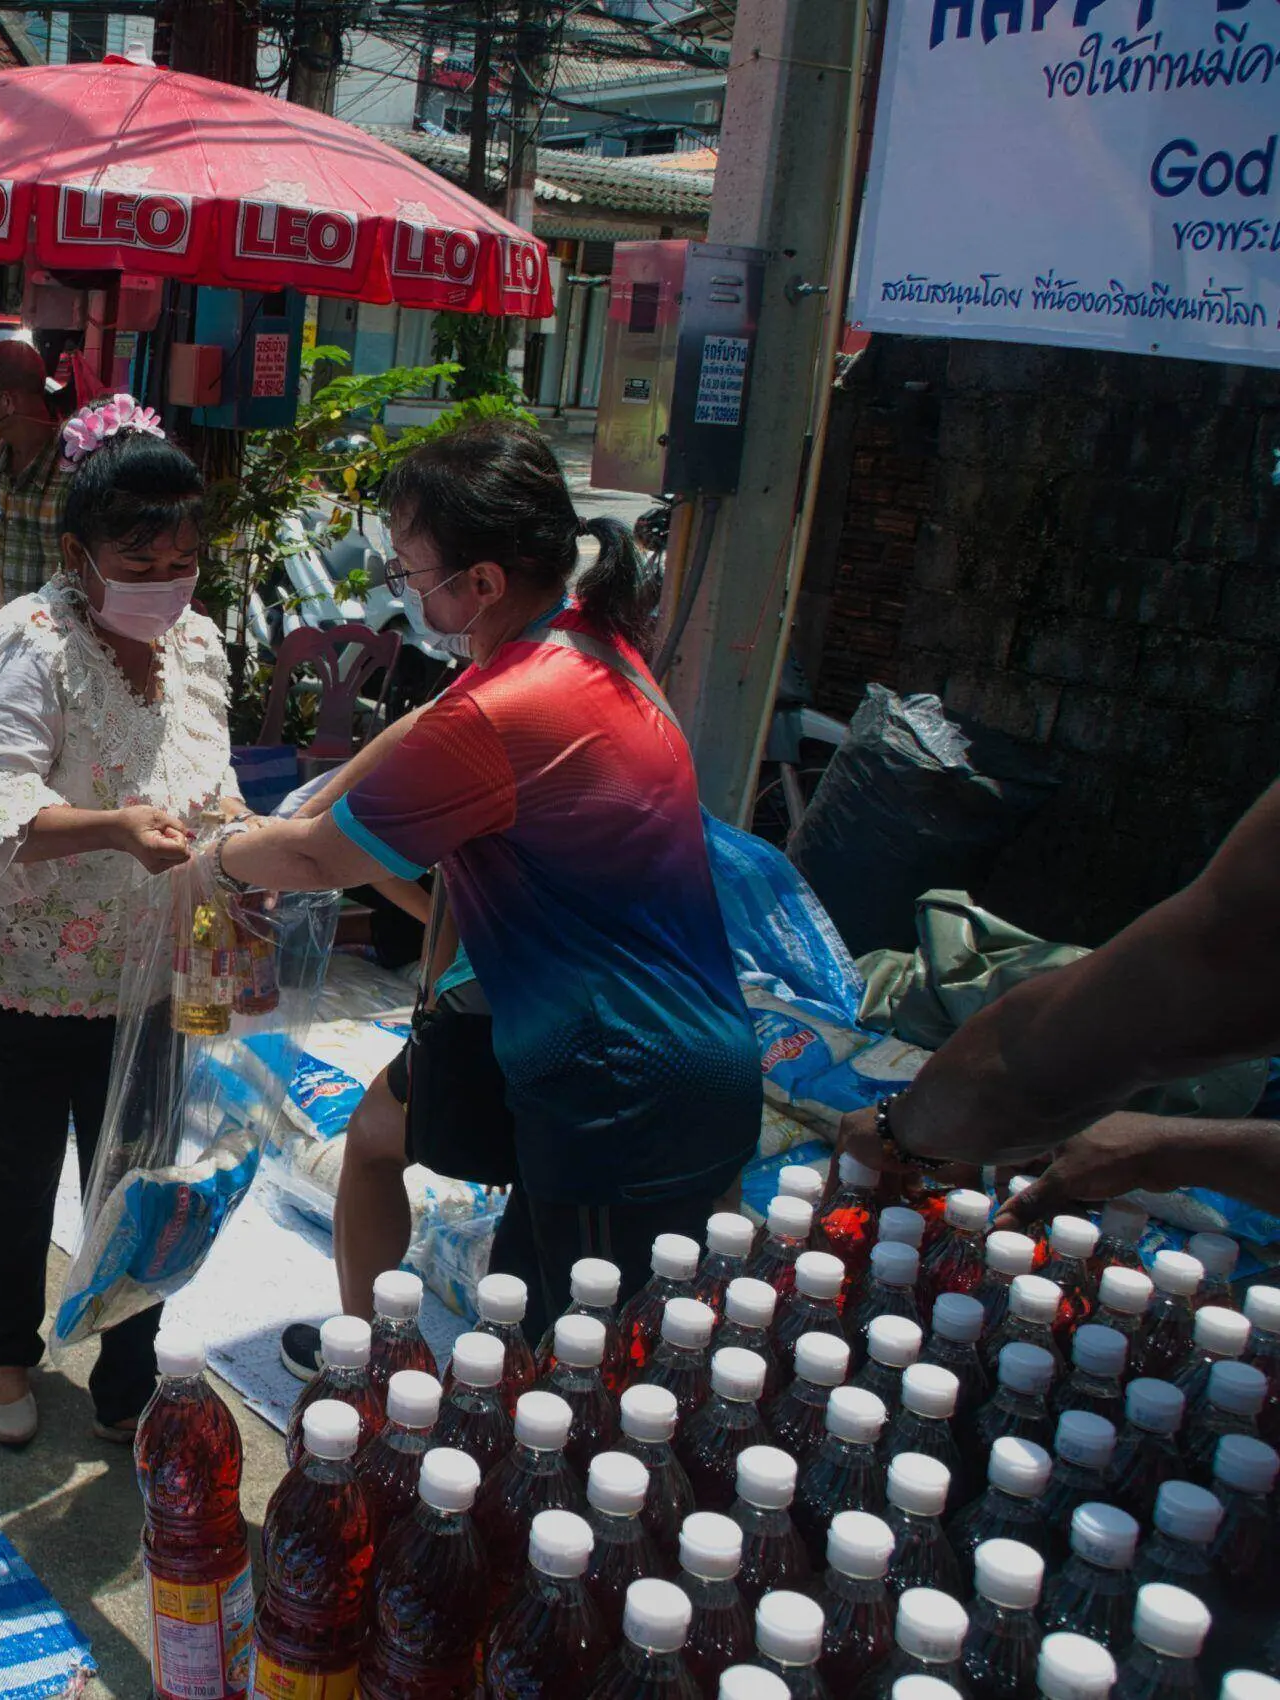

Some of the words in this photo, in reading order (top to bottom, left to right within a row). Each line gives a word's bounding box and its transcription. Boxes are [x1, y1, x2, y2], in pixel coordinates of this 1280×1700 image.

[1042, 21, 1280, 98] ขอให้ท่านมีค
[1150, 134, 1278, 198] God
[61, 184, 186, 250] LEO
[239, 201, 357, 265] LEO
[394, 221, 479, 282] LEO
[499, 235, 542, 292] LEO
